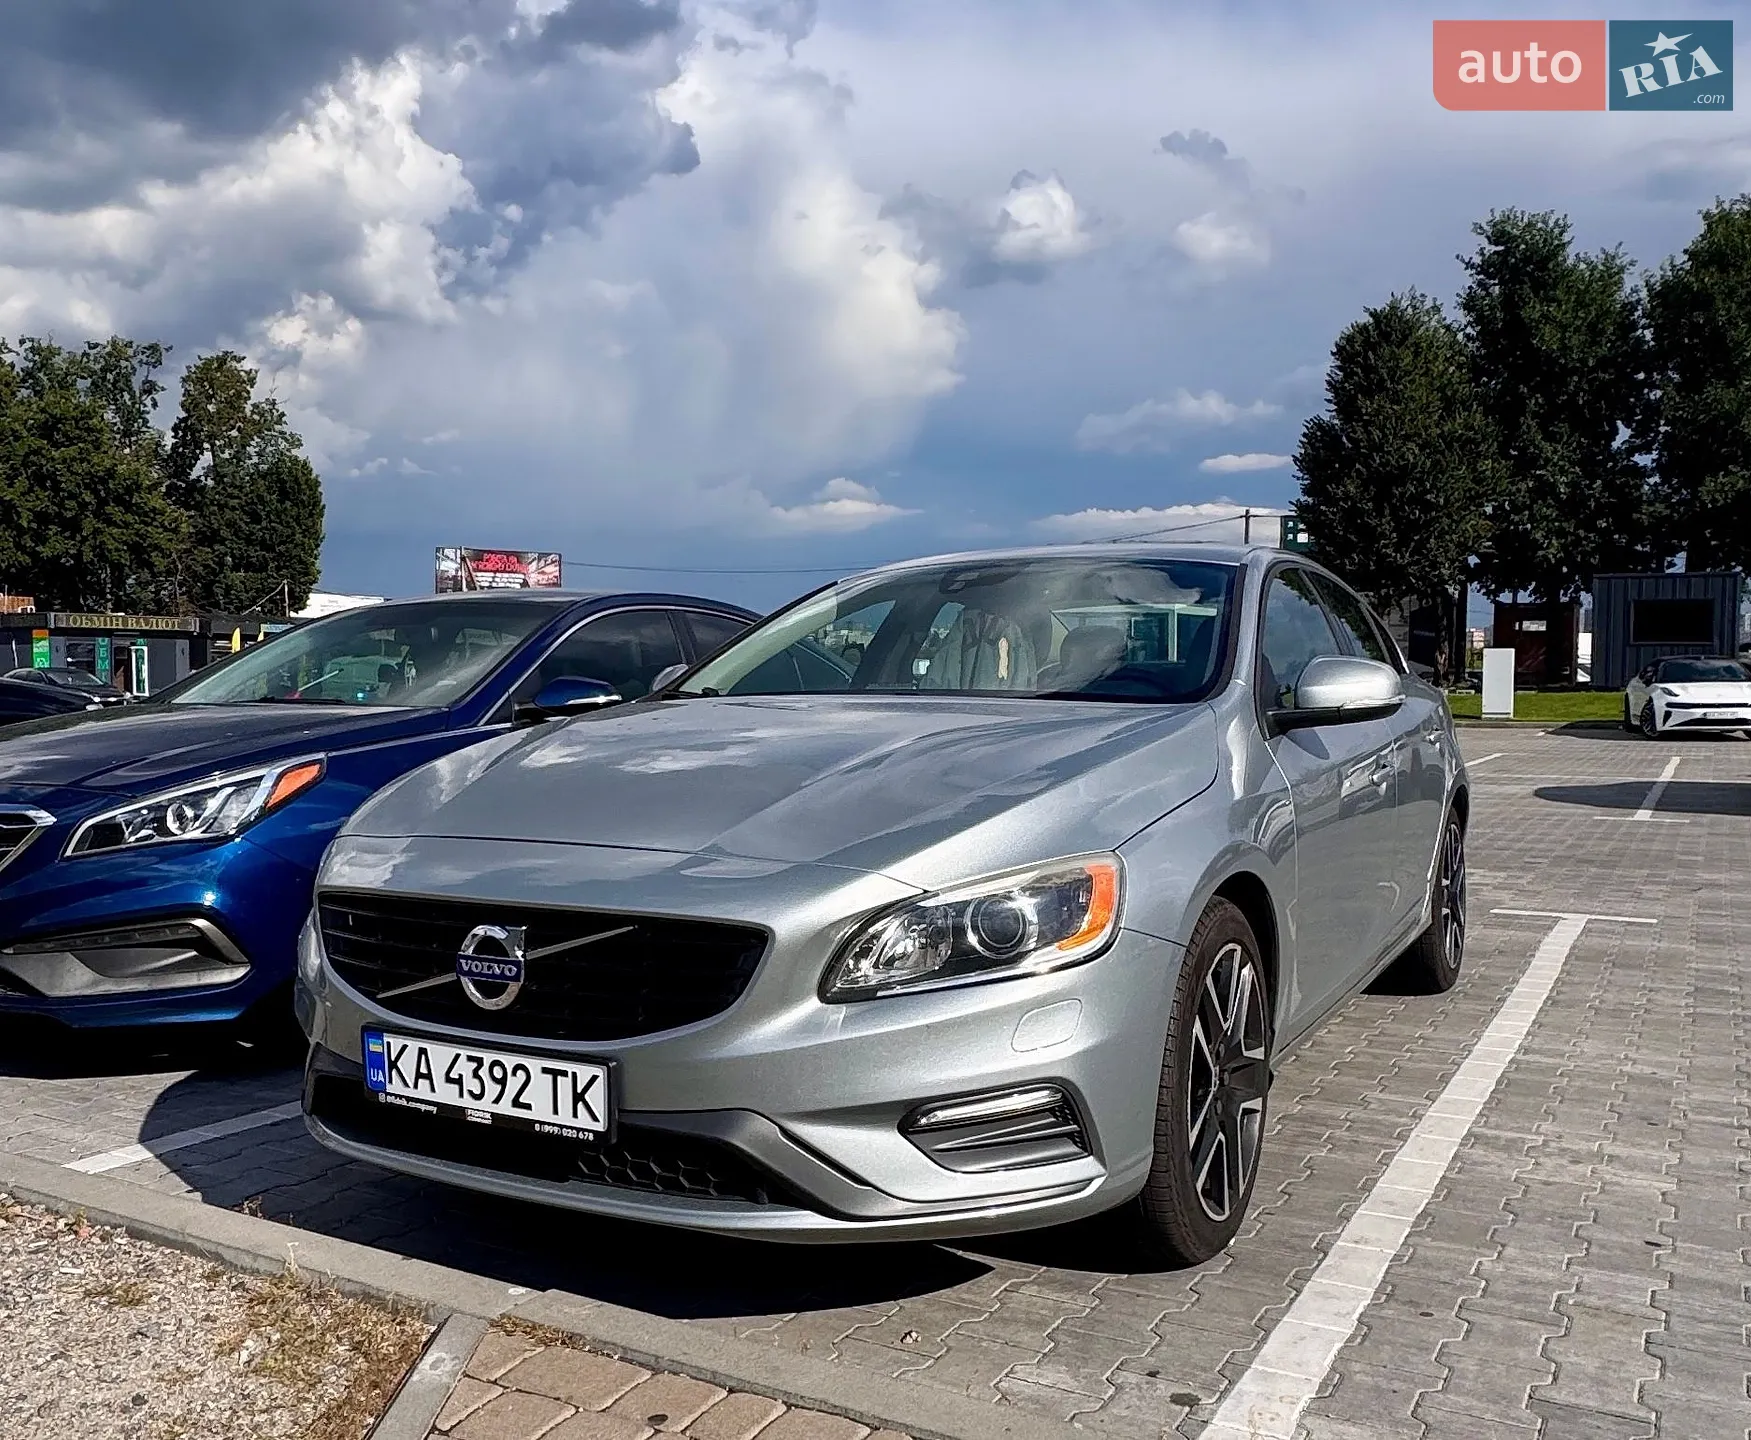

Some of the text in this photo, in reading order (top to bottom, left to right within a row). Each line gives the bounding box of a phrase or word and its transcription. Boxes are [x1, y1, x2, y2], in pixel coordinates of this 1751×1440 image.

[69, 614, 180, 631] ОБМІН ВАЛЮТ
[460, 959, 517, 977] VOLVO
[370, 1068, 385, 1083] UA
[386, 1041, 600, 1123] KA 4392 TK
[578, 1130, 594, 1141] 678
